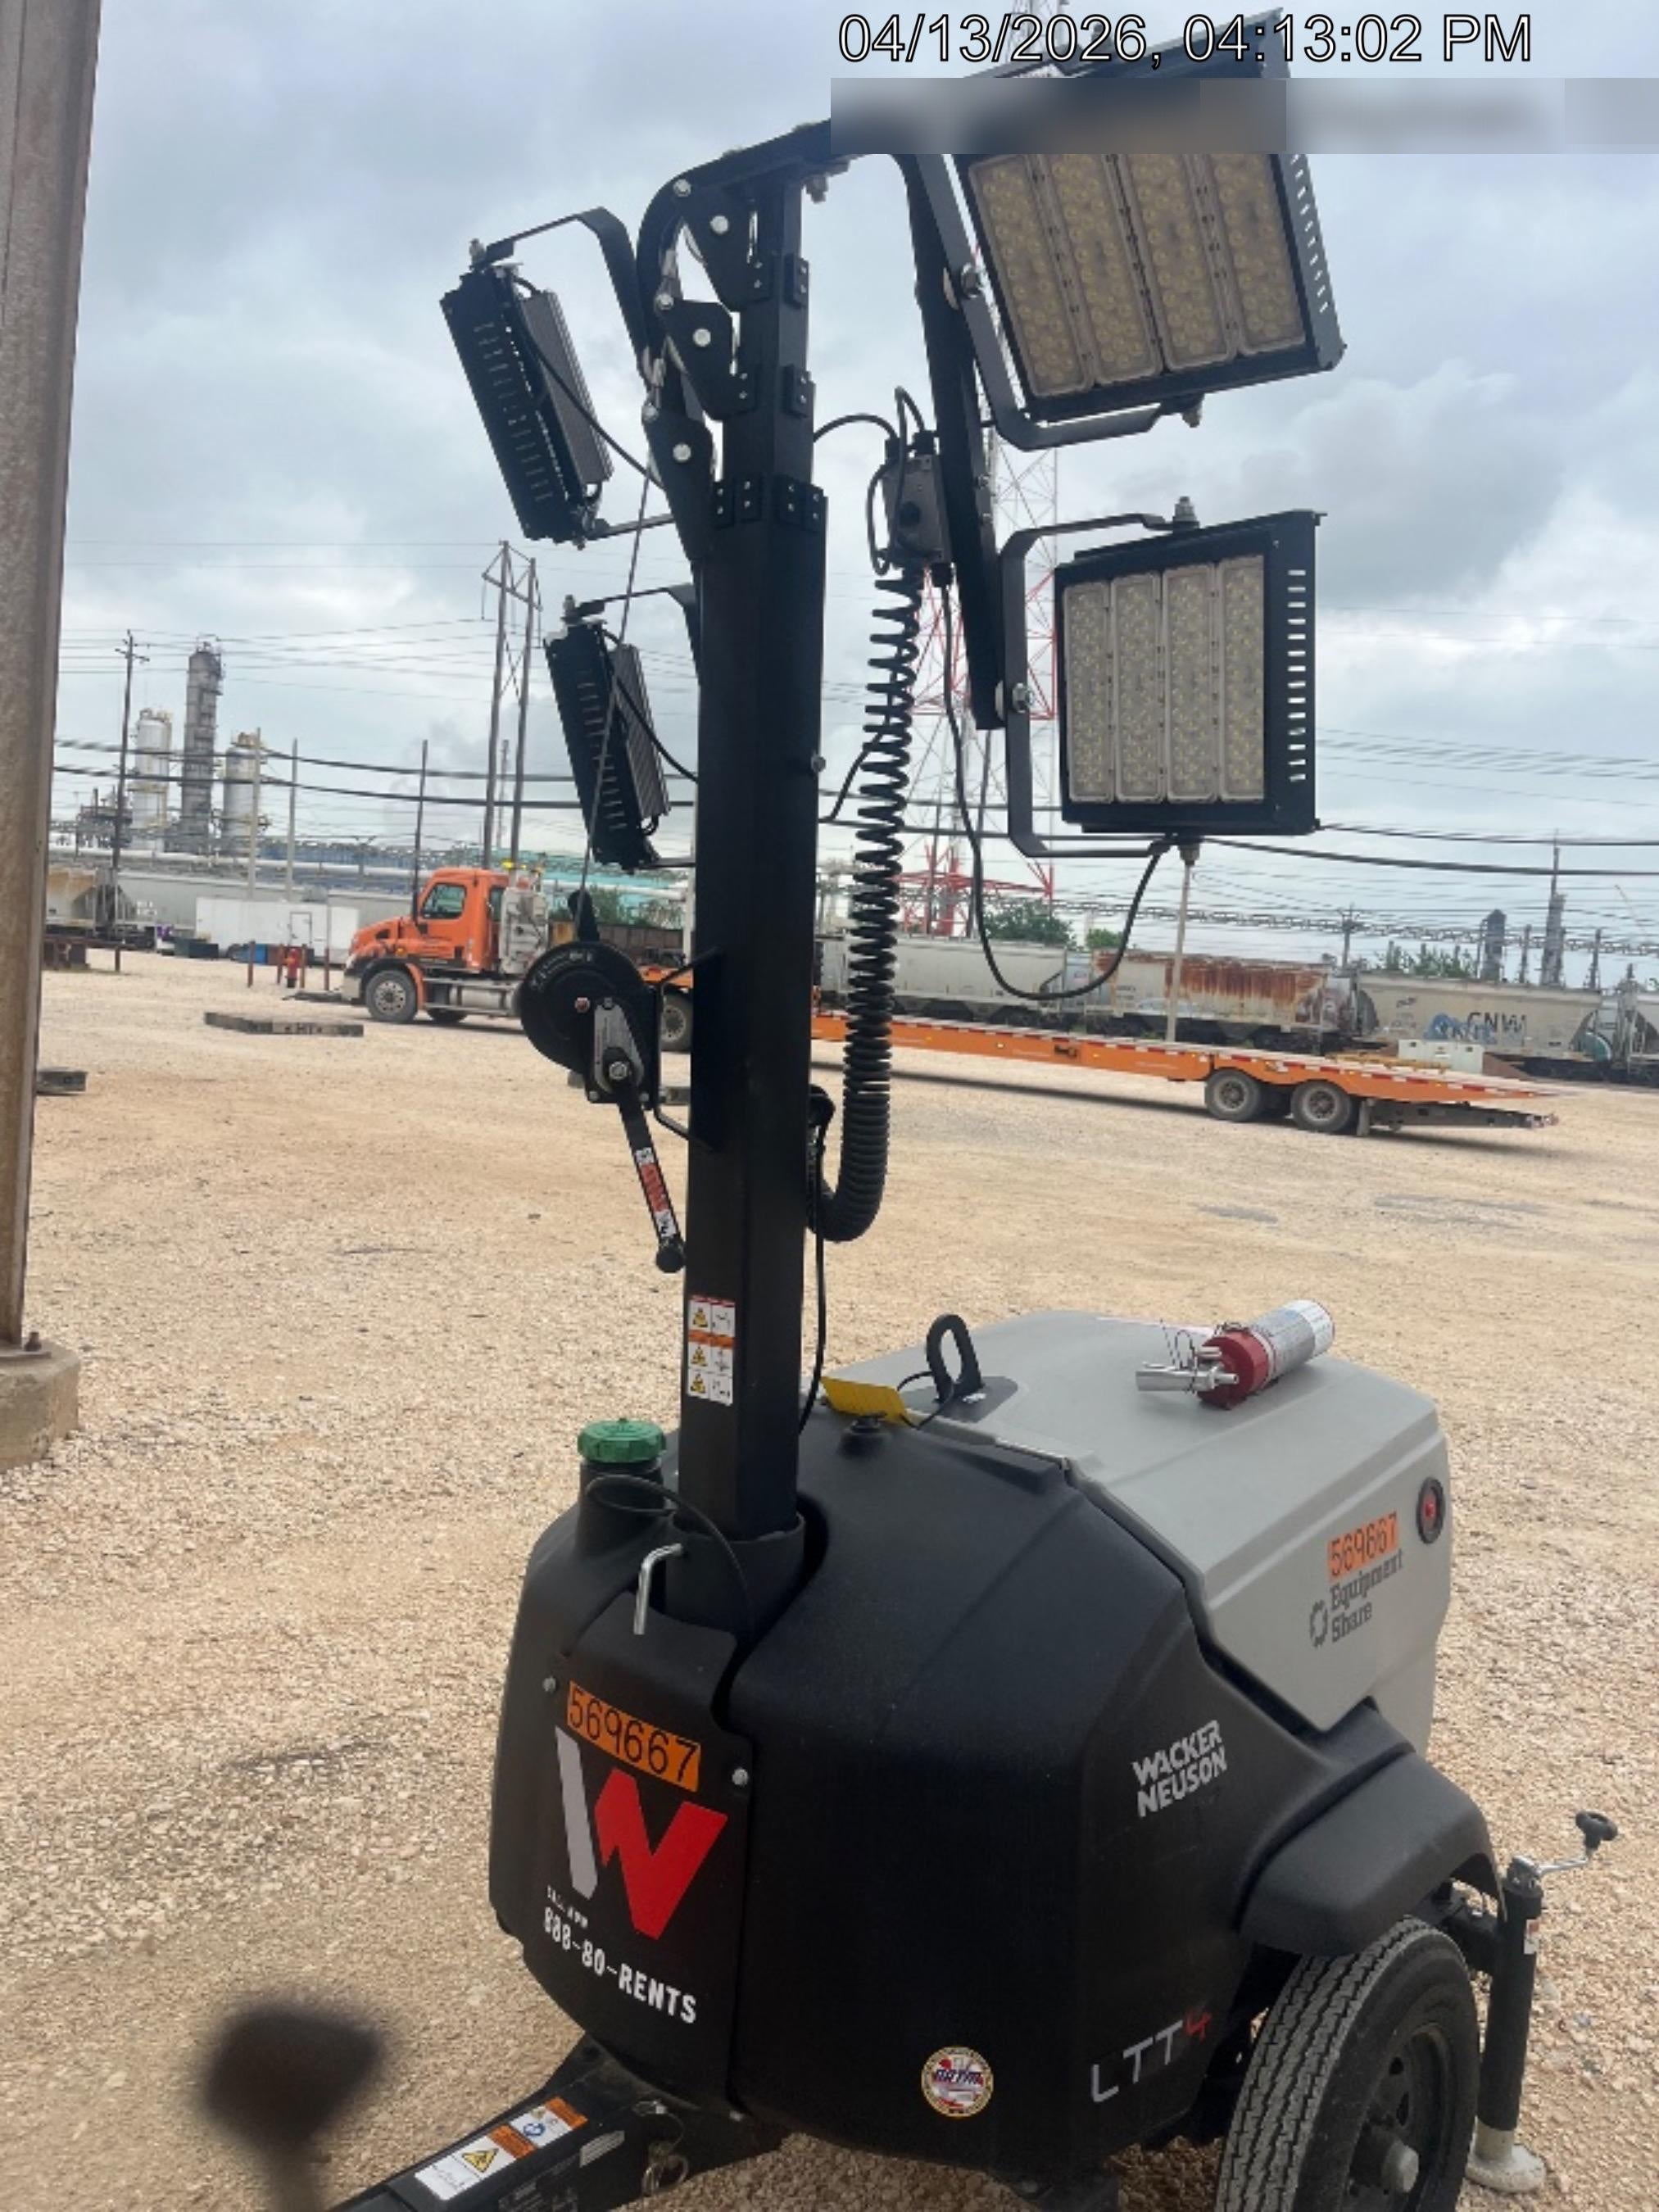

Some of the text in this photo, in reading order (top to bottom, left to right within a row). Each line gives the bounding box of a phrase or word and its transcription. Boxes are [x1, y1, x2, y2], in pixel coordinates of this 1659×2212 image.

[1330, 1548, 1403, 1610] Equipment
[1330, 1601, 1373, 1643] Share
[569, 1688, 700, 1784] 569667
[1131, 1719, 1222, 1786] WACKER
[1136, 1746, 1228, 1818] NEUSON
[543, 1906, 697, 2024] 888-80-RENTS
